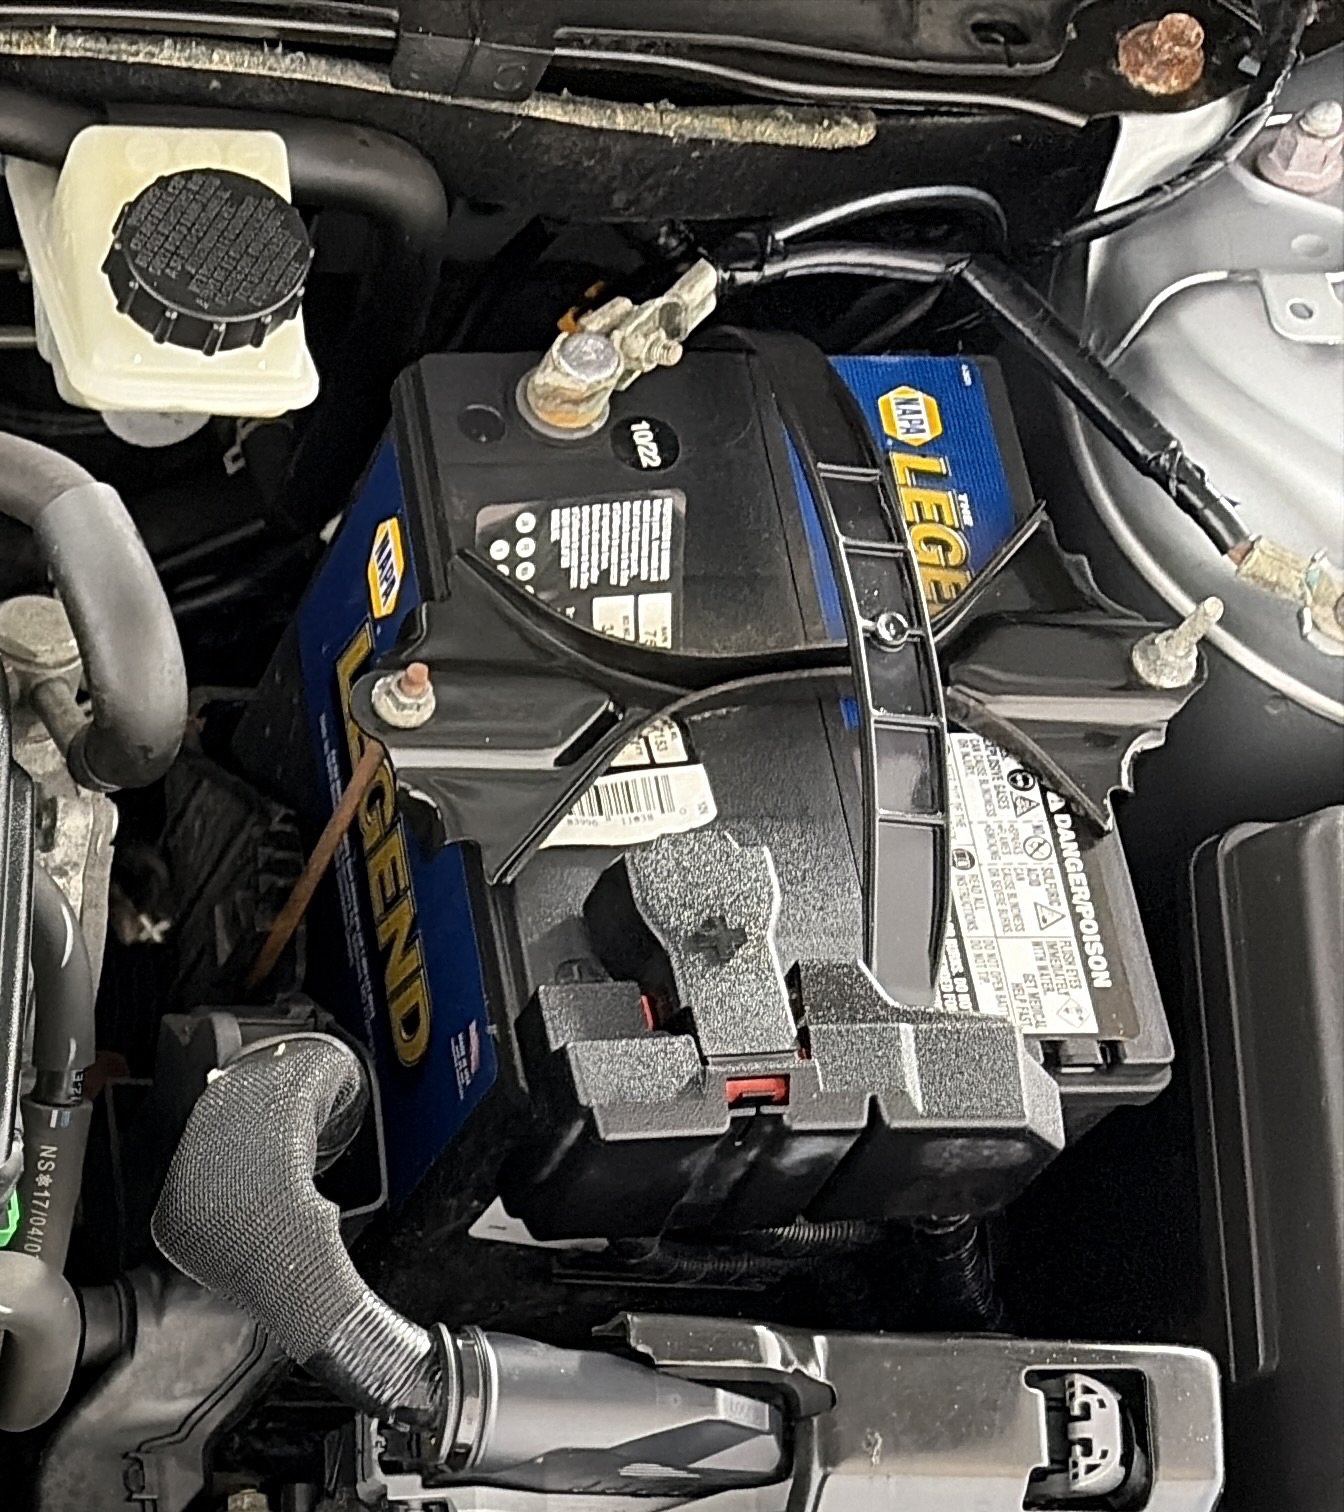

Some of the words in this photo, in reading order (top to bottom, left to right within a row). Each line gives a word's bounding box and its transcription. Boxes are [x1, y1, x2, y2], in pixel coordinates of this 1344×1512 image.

[630, 420, 662, 468] 10/22
[895, 398, 927, 435] NAPA
[889, 450, 971, 612] LEGE
[958, 492, 973, 527] THE
[375, 529, 396, 607] NAPA
[331, 617, 430, 1067] LGEND
[1054, 814, 1112, 988] DANGER/POISON
